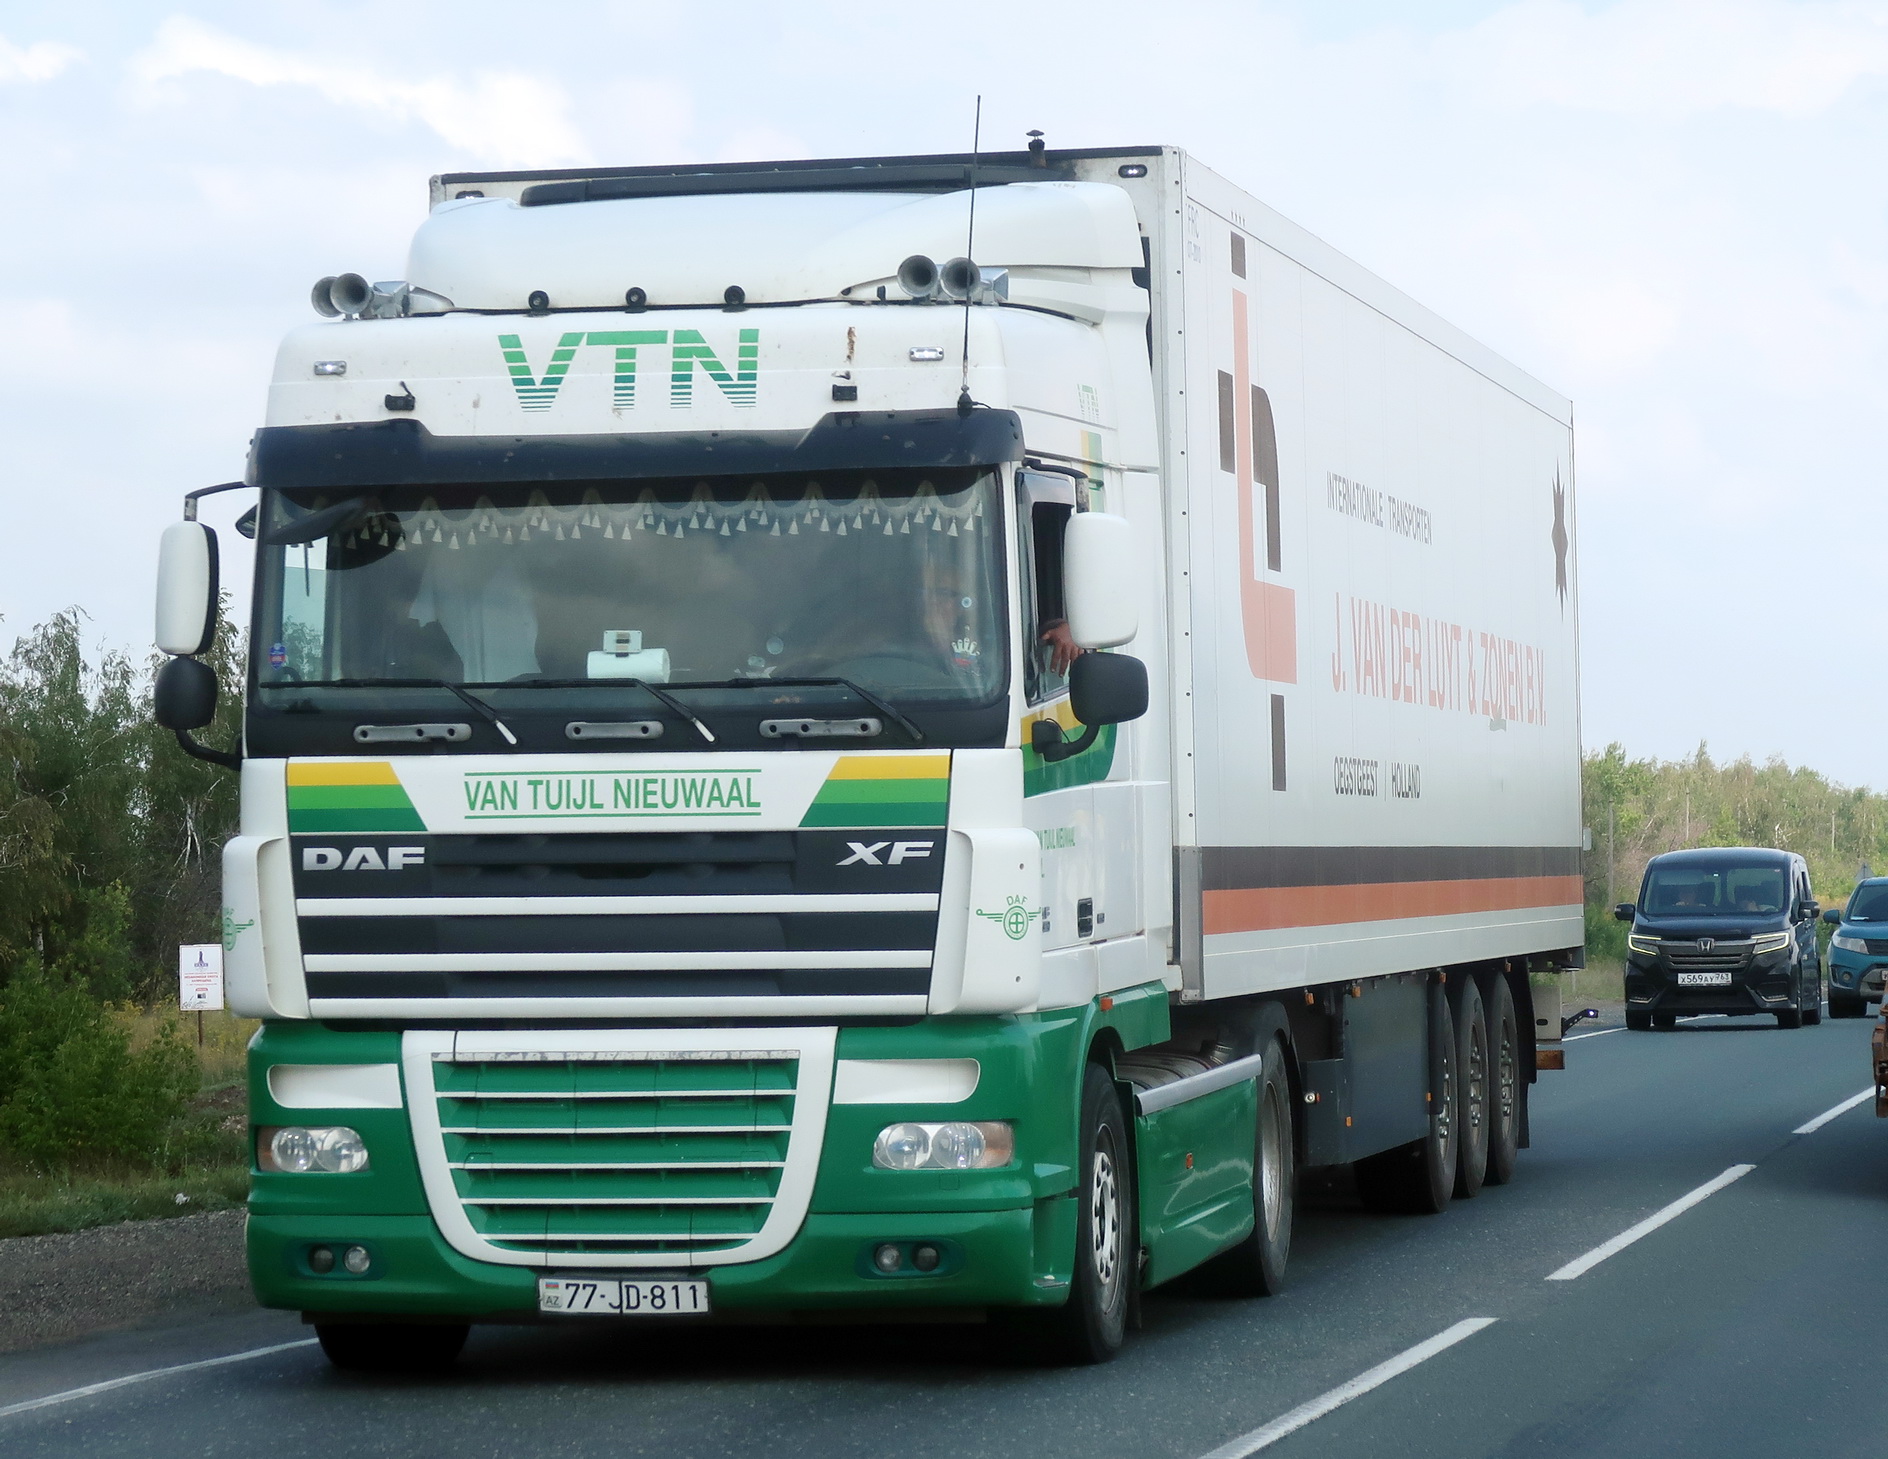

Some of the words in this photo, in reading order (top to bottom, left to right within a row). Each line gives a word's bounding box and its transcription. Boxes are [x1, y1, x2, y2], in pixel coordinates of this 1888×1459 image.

[497, 328, 760, 413] VTN
[1327, 470, 1384, 528] INTERNATIONALE
[1388, 495, 1433, 546] TRANSPORTEN
[1332, 592, 1346, 693] J.
[1351, 597, 1386, 698] VAN
[1390, 608, 1423, 705] DER
[1427, 617, 1462, 712] LUYT
[1467, 628, 1477, 715] &
[1480, 632, 1524, 723] ZONEN
[1333, 756, 1379, 797] OEGSTGEEST
[1391, 762, 1421, 799] HOLLAND
[464, 780, 519, 812] VAN
[526, 778, 604, 810] TUIJL
[614, 776, 761, 810] NIEUWAAL
[302, 846, 426, 870] DAF
[836, 841, 934, 866] XF
[1006, 894, 1028, 906] DAF
[546, 1295, 560, 1307] AZ
[565, 1283, 698, 1310] 77-JD-811
